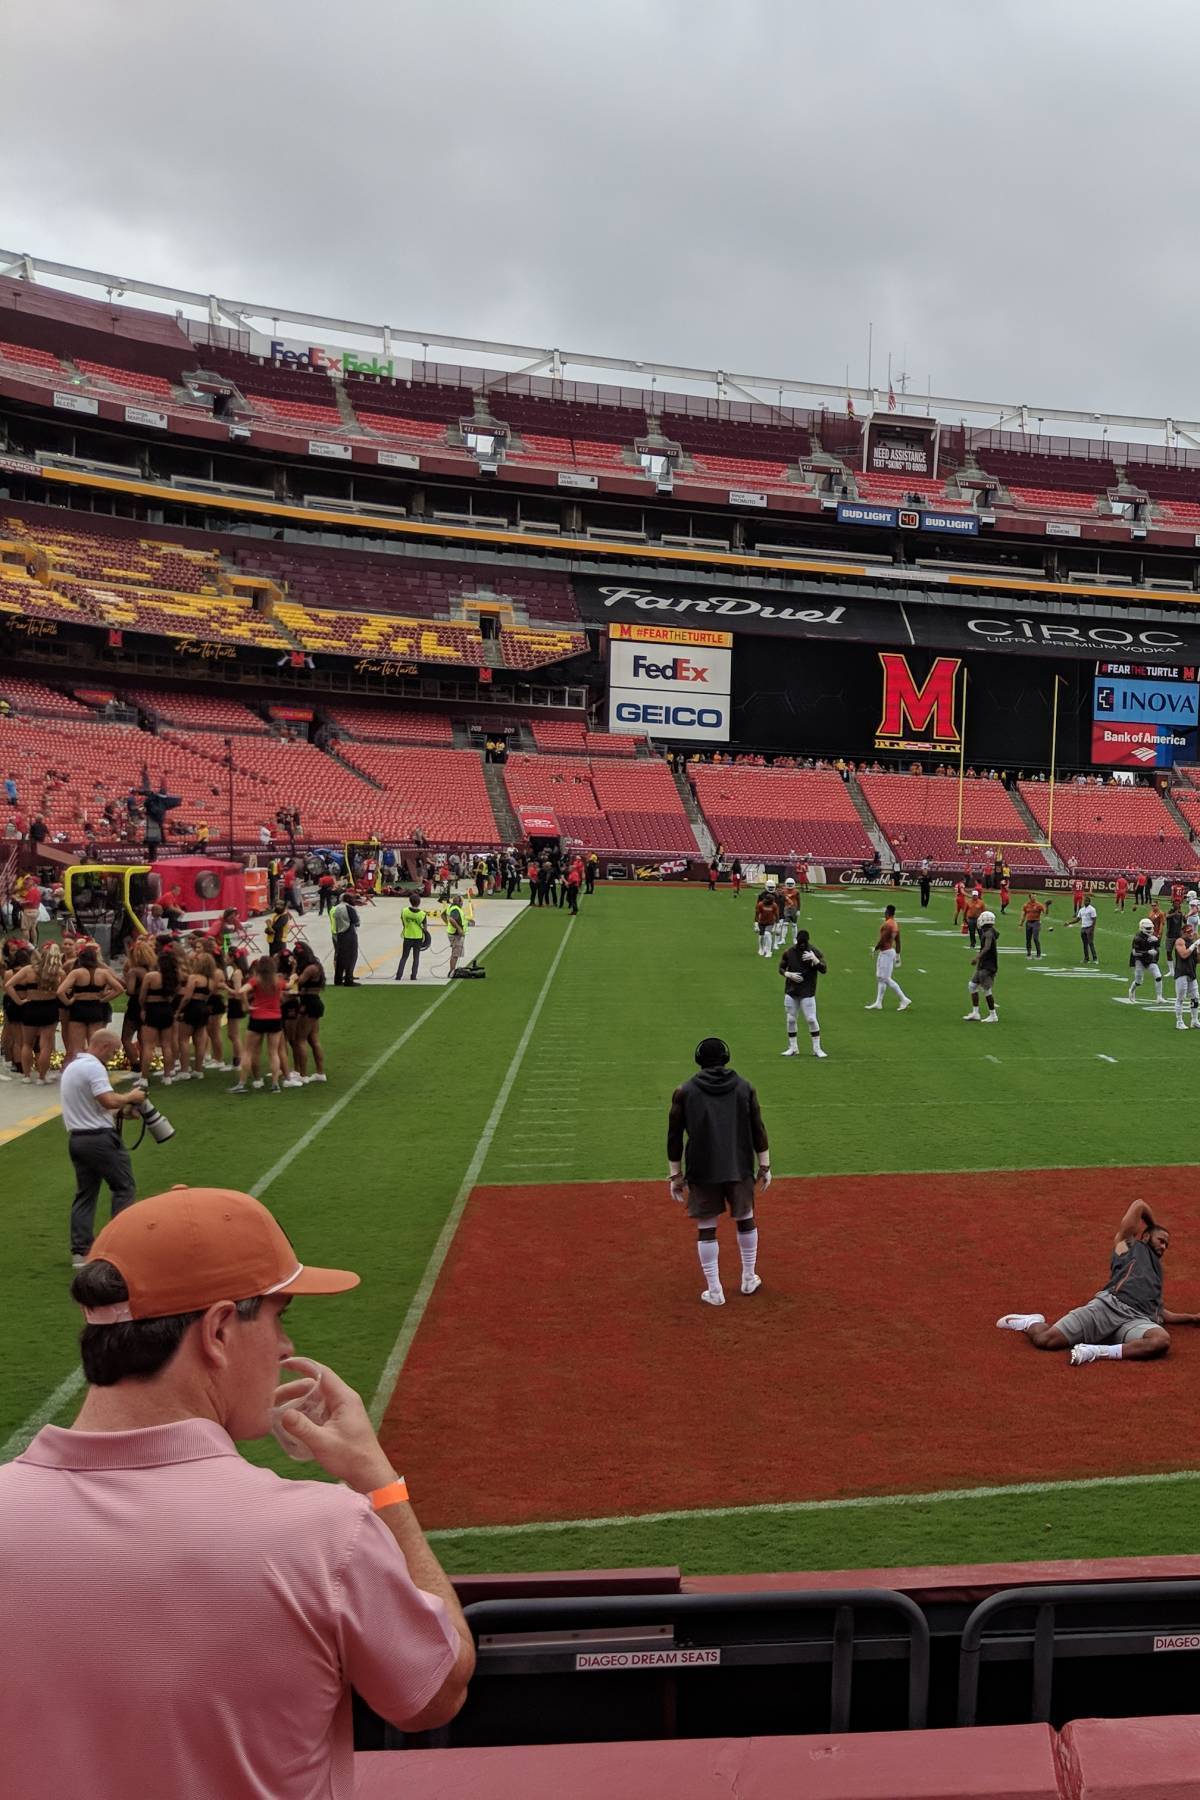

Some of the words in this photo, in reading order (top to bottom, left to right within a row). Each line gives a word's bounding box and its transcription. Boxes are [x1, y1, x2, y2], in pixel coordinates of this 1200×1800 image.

[271, 341, 394, 378] FedExField
[873, 458, 884, 468] TEXT
[906, 462, 912, 470] TO
[874, 448, 890, 460] NEED
[890, 450, 926, 463] ASSISTANCE
[842, 509, 863, 519] BUD
[864, 511, 892, 521] LIGHT
[902, 515, 916, 525] 40
[926, 518, 946, 527] BUD
[947, 520, 974, 530] LIGHT
[598, 587, 847, 624] FanDuel
[620, 625, 632, 640] M
[636, 628, 723, 644] #FEARTHETURTLE
[968, 618, 1184, 646] CÎROC
[987, 636, 1036, 645] ULTRA
[1042, 640, 1118, 650] PREMIUM
[1121, 646, 1176, 654] VODKA
[634, 655, 708, 682] FedEx
[1102, 664, 1178, 678] #FEARTHETURTLE
[876, 653, 962, 740] M
[1122, 691, 1195, 714] INOVA
[616, 703, 722, 728] GEICO
[1104, 731, 1130, 743] Bank
[1132, 731, 1143, 743] of
[1144, 733, 1186, 746] America
[840, 870, 894, 884] Charable
[1156, 1636, 1200, 1649] DIAGEO
[578, 1654, 629, 1668] DIAGEO
[632, 1652, 678, 1666] DREAM
[682, 1650, 718, 1664] SEATS
